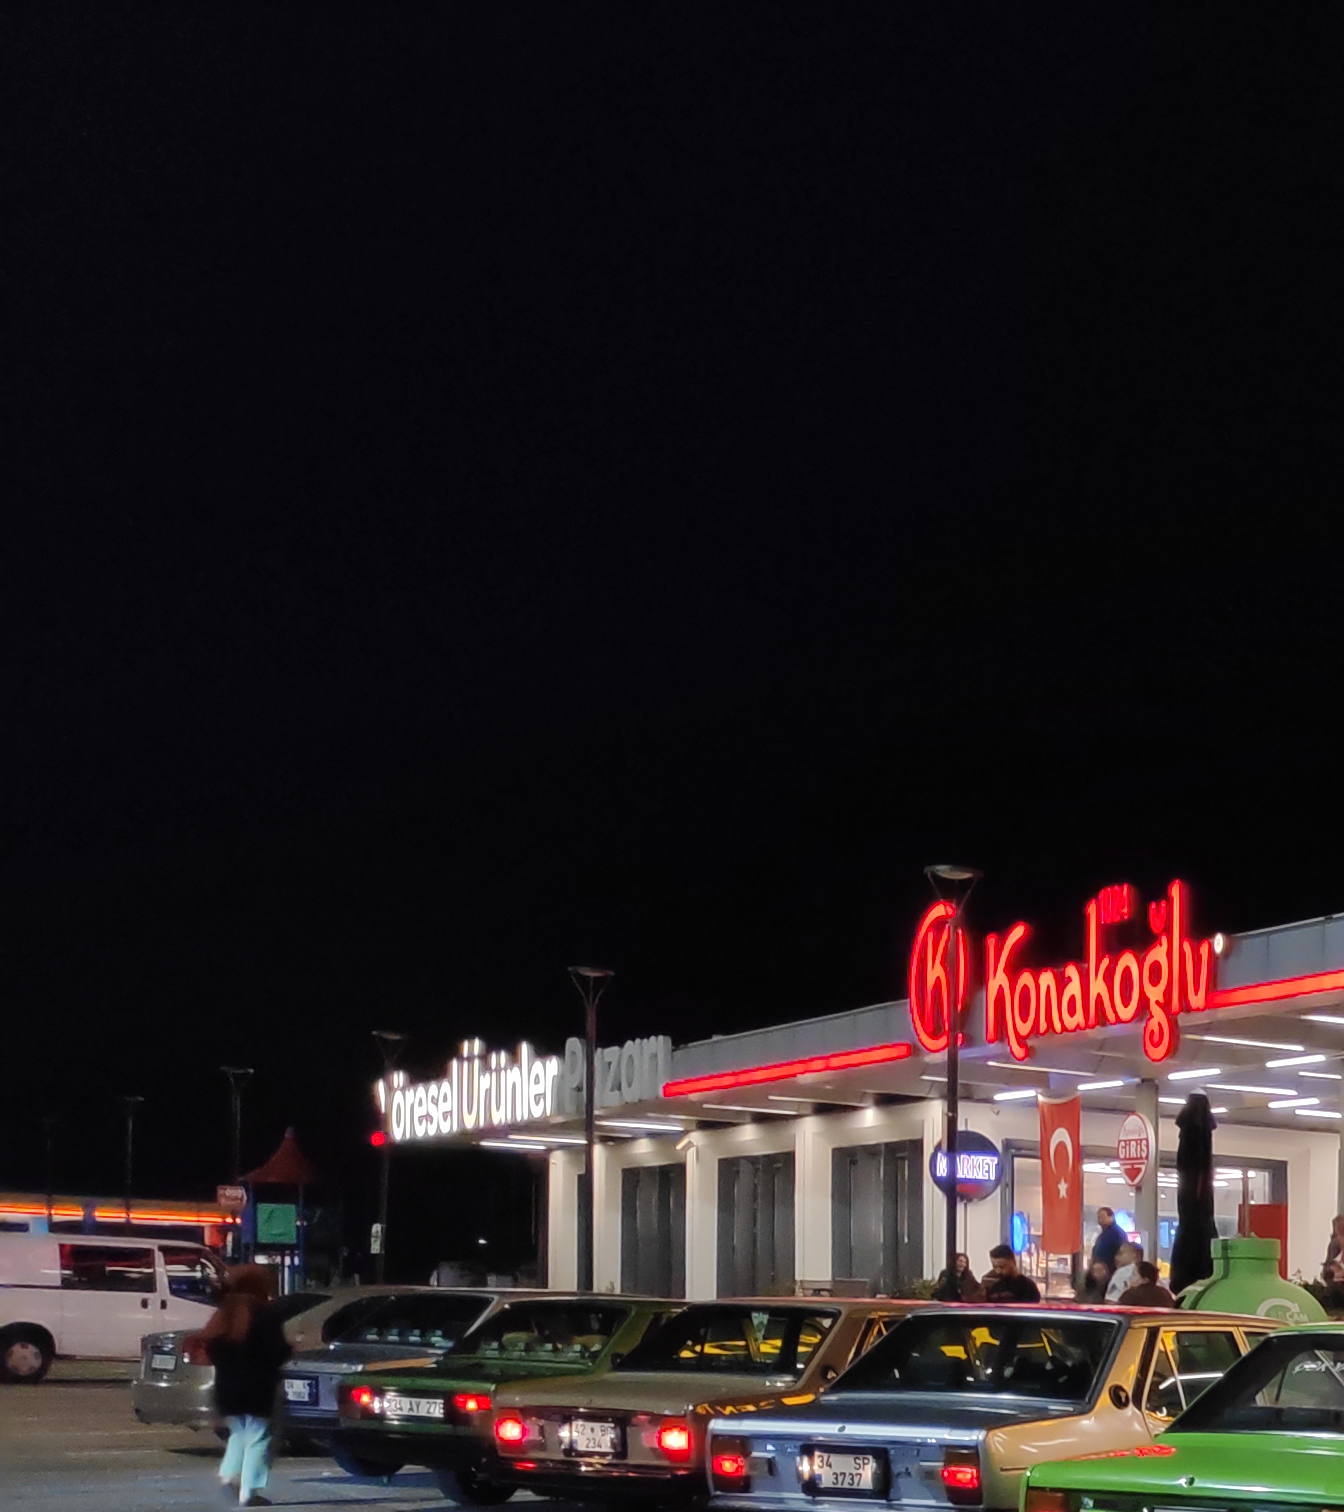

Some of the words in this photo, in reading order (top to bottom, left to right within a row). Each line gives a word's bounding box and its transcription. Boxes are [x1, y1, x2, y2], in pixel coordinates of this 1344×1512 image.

[985, 878, 1211, 1063] Konakoğlu
[461, 1036, 559, 1129] Ürünler
[817, 1454, 832, 1469] 34
[853, 1456, 870, 1471] SP
[831, 1472, 863, 1487] 3737
